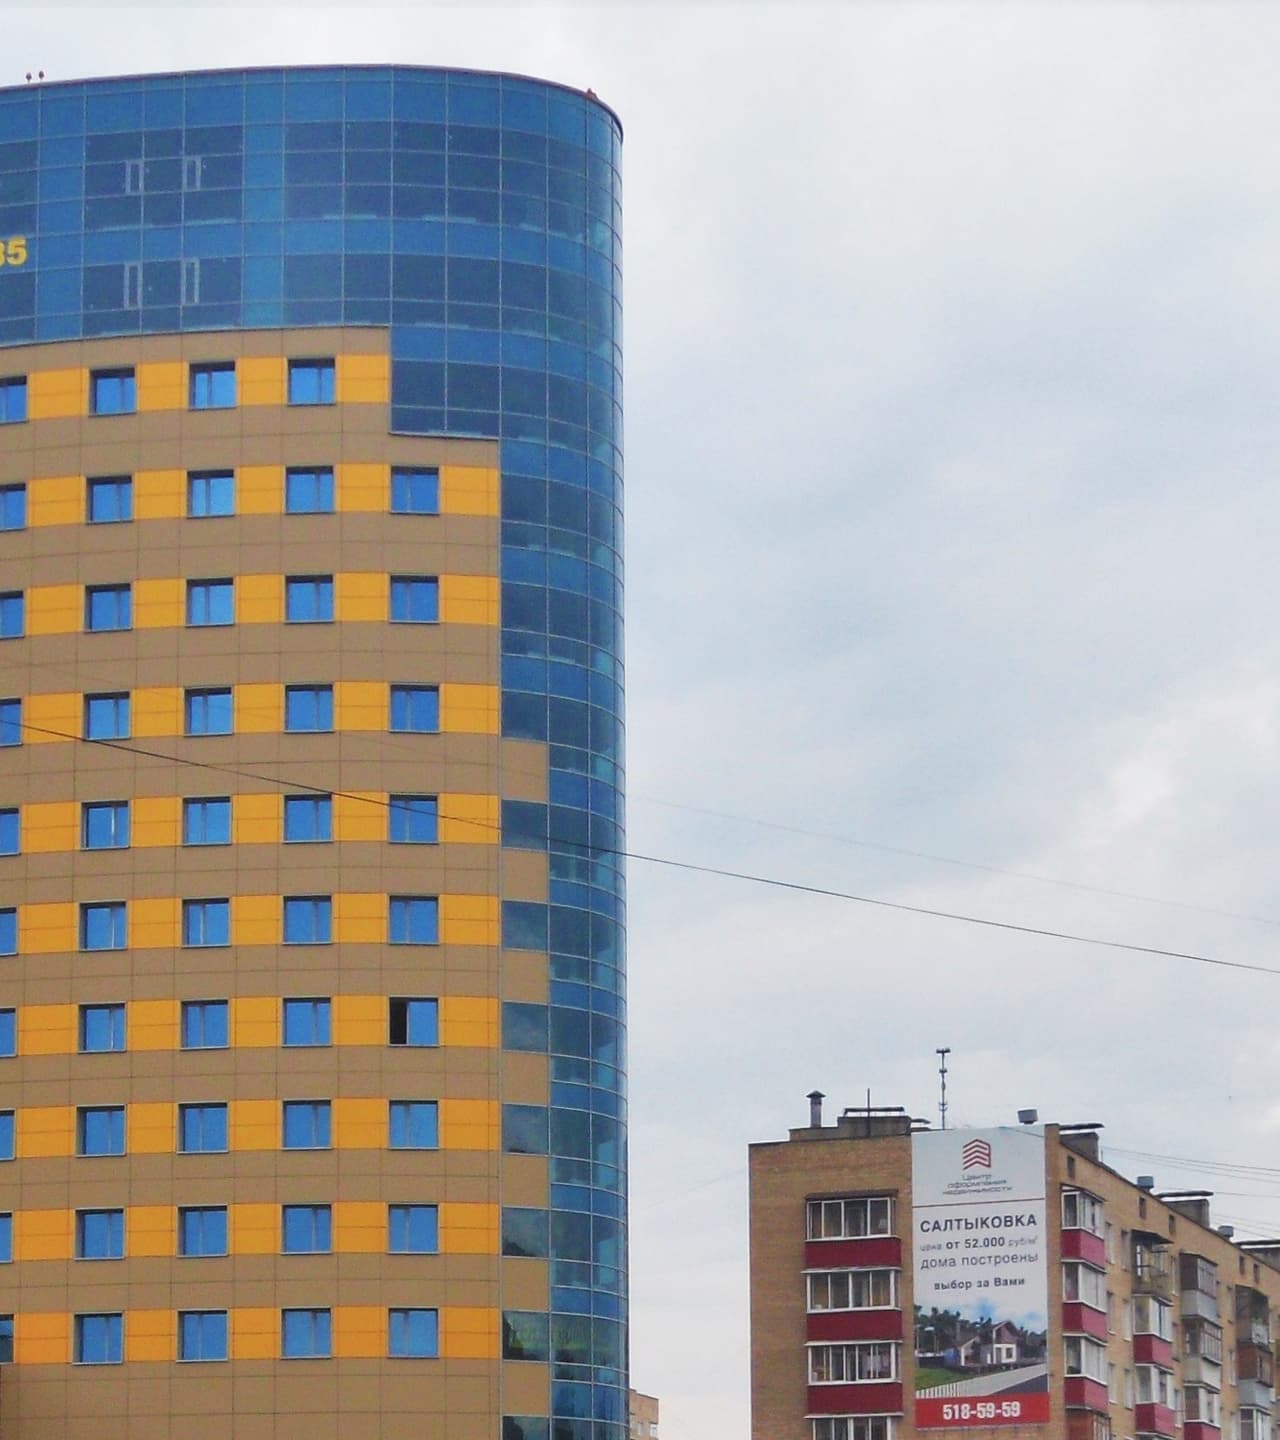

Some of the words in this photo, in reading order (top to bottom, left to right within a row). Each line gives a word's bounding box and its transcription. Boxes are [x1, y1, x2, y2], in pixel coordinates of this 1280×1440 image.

[920, 1214, 1037, 1232] САЛТЫКОВКА
[946, 1241, 960, 1249] от
[964, 1237, 1005, 1249] 52.000
[920, 1258, 956, 1270] дома
[961, 1253, 1038, 1266] построены
[934, 1280, 972, 1290] выбор
[994, 1277, 1025, 1287] Вами
[942, 1401, 1021, 1420] 518-59-59
